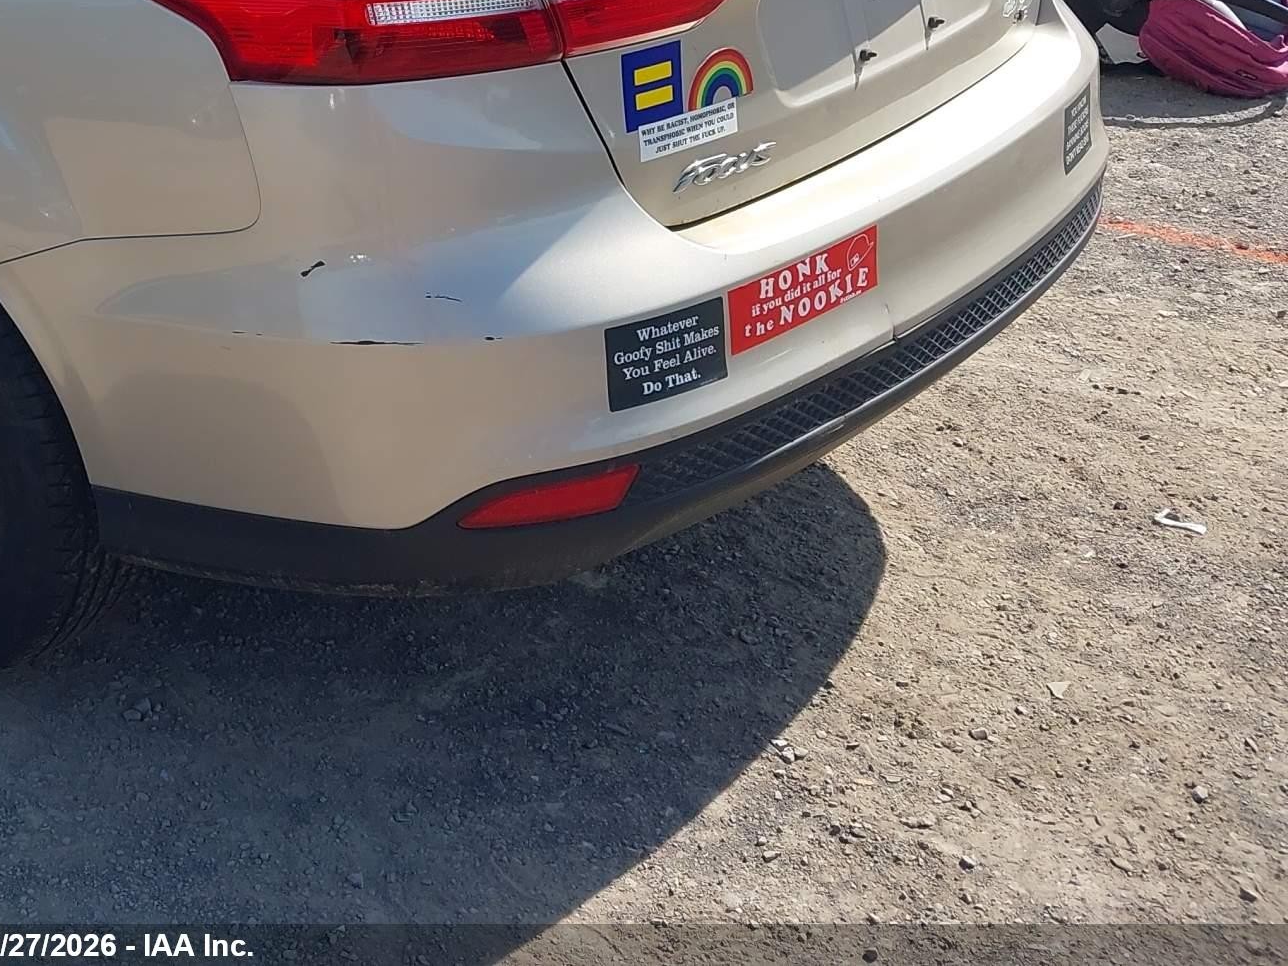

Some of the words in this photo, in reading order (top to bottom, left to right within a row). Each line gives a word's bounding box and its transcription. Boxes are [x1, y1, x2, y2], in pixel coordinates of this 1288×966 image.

[641, 126, 656, 138] WHY
[657, 124, 665, 133] BE
[666, 118, 689, 131] RACIST,
[690, 105, 727, 124] HOMOPHOBIC,
[727, 102, 735, 110] OR
[643, 128, 685, 146] TRANSPHOBIC
[686, 123, 704, 134] WHEN
[704, 118, 716, 128] YOU
[716, 112, 734, 124] COULD
[655, 143, 671, 154] JUST
[672, 138, 688, 149] SHUT
[689, 134, 701, 143] THE
[701, 129, 716, 140] FUCK
[717, 125, 726, 134] UP.
[751, 304, 761, 317] if
[762, 297, 782, 314] you
[784, 289, 801, 302] did
[802, 282, 811, 294] it
[813, 275, 825, 289] all
[827, 268, 841, 282] for
[759, 253, 829, 299] HONK
[744, 319, 774, 337] the
[779, 267, 869, 325] NOOKIE
[614, 346, 652, 365] Goofy
[655, 336, 681, 354] Shit
[683, 326, 720, 346] Makes
[637, 315, 699, 342] Whatever
[622, 365, 650, 380] You
[654, 354, 681, 372] Feel
[683, 345, 717, 363] Alive.
[642, 382, 662, 395] Do
[665, 367, 702, 388] That.
